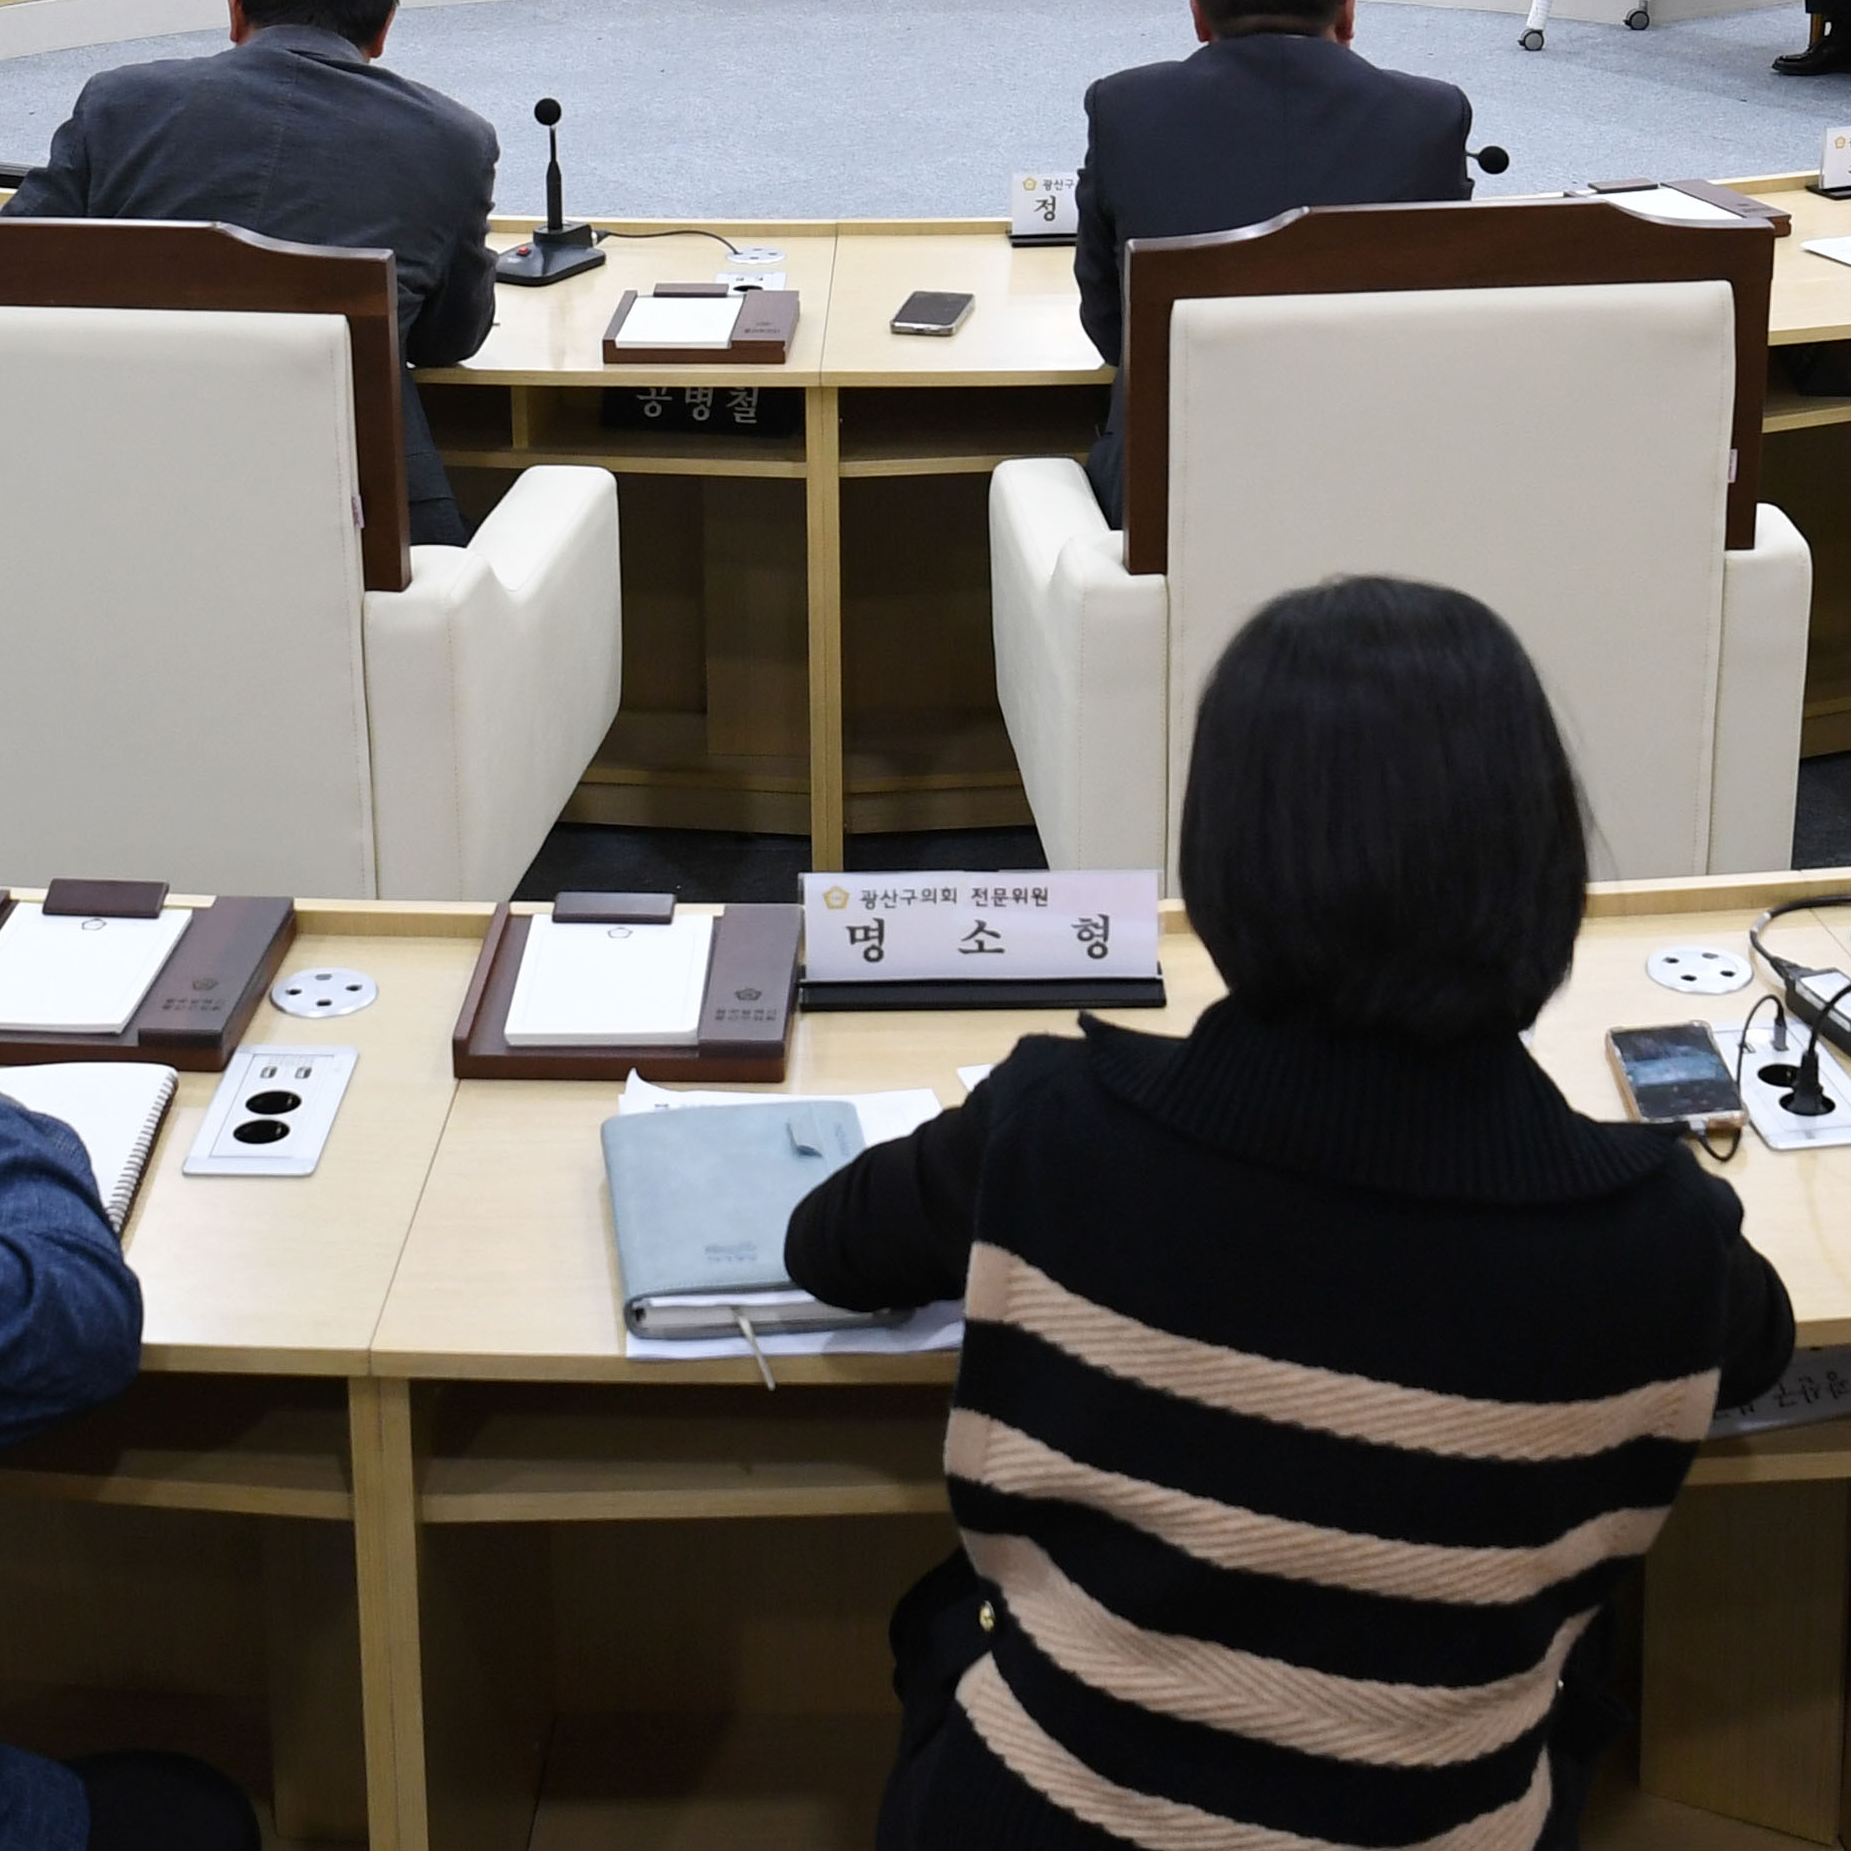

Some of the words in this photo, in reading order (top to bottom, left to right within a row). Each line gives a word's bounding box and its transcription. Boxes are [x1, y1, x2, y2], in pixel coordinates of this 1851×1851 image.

[1033, 194, 1056, 222] 정
[860, 887, 958, 910] 광산구의회
[971, 887, 1050, 908] 전문위원
[845, 917, 886, 964] 명
[957, 919, 1006, 955] 소
[1070, 913, 1111, 960] 형
